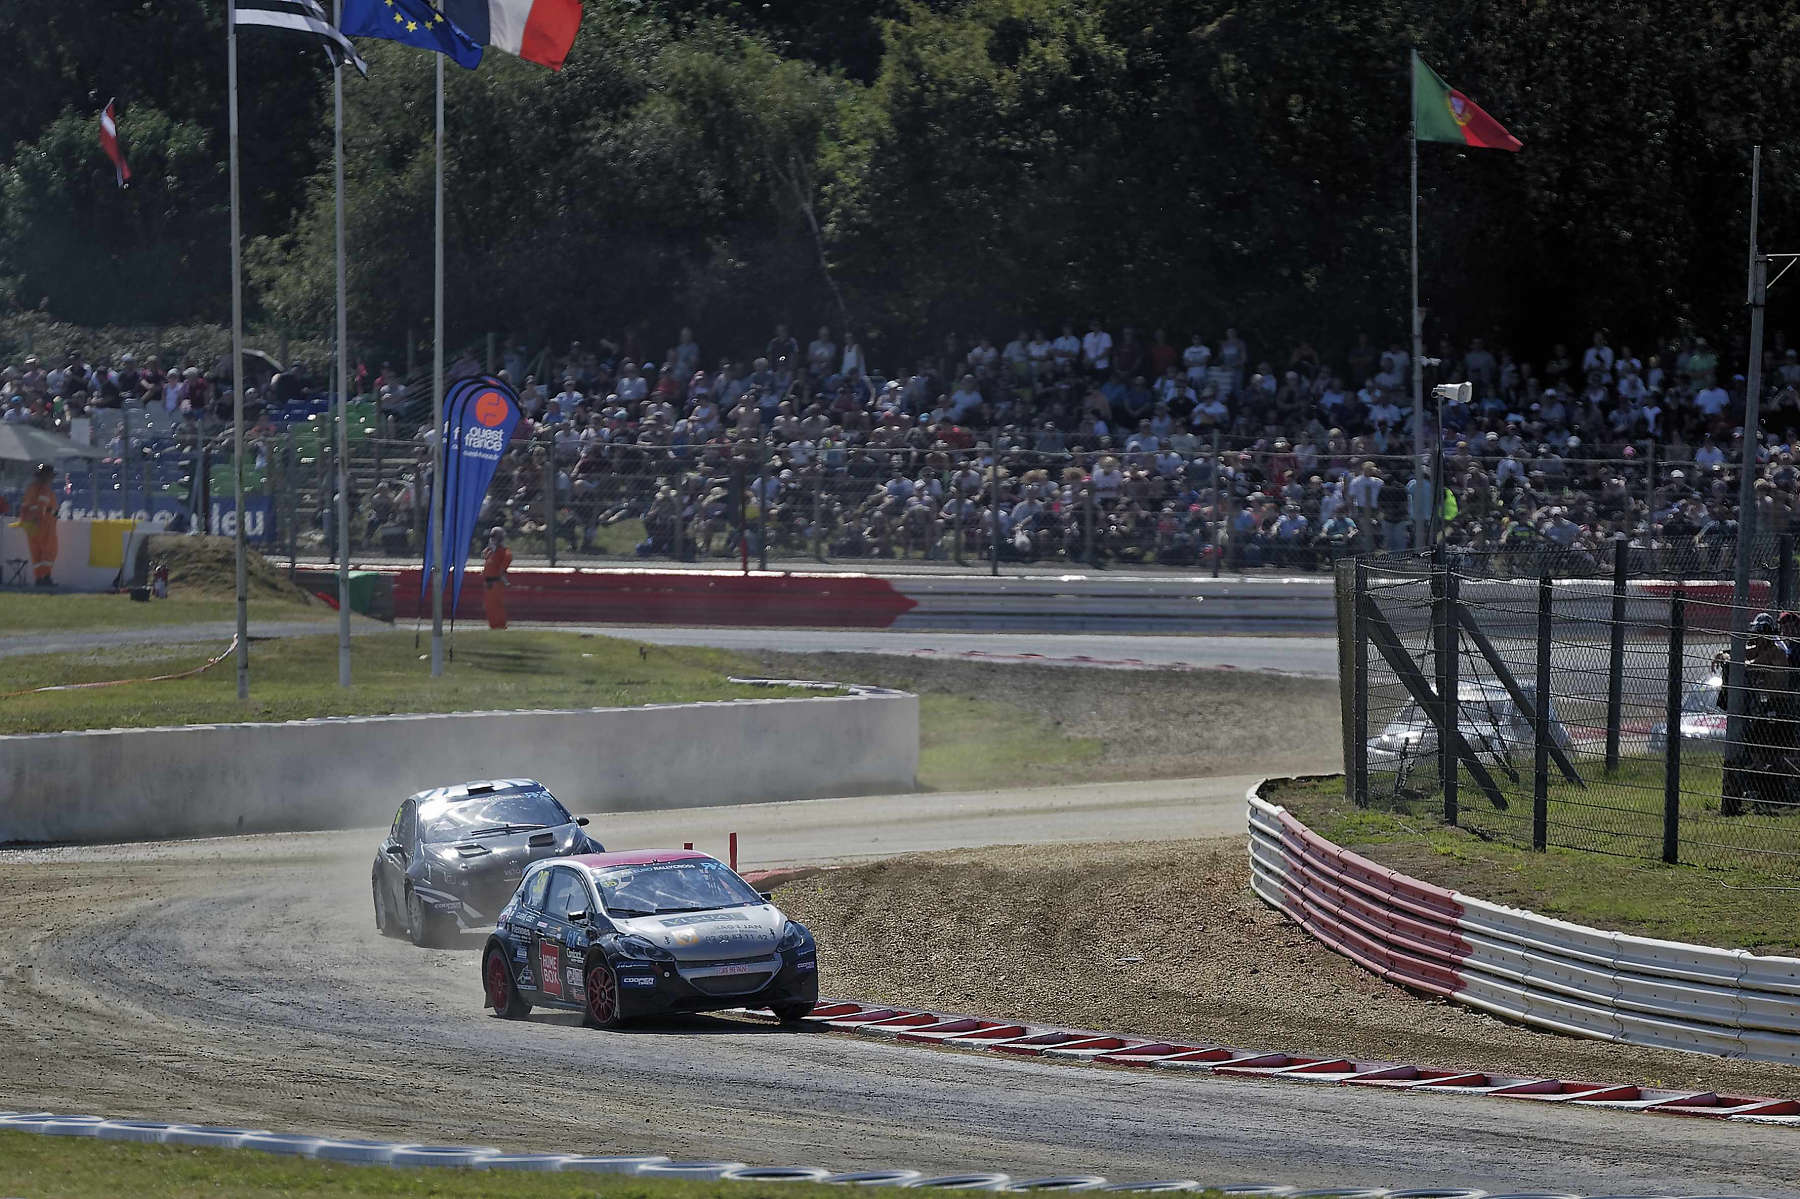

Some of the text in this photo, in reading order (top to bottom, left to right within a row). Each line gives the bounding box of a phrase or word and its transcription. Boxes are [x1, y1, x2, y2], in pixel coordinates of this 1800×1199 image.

[469, 426, 504, 441] ouest
[464, 433, 503, 452] france
[542, 954, 557, 970] HOME
[543, 968, 559, 984] BOX
